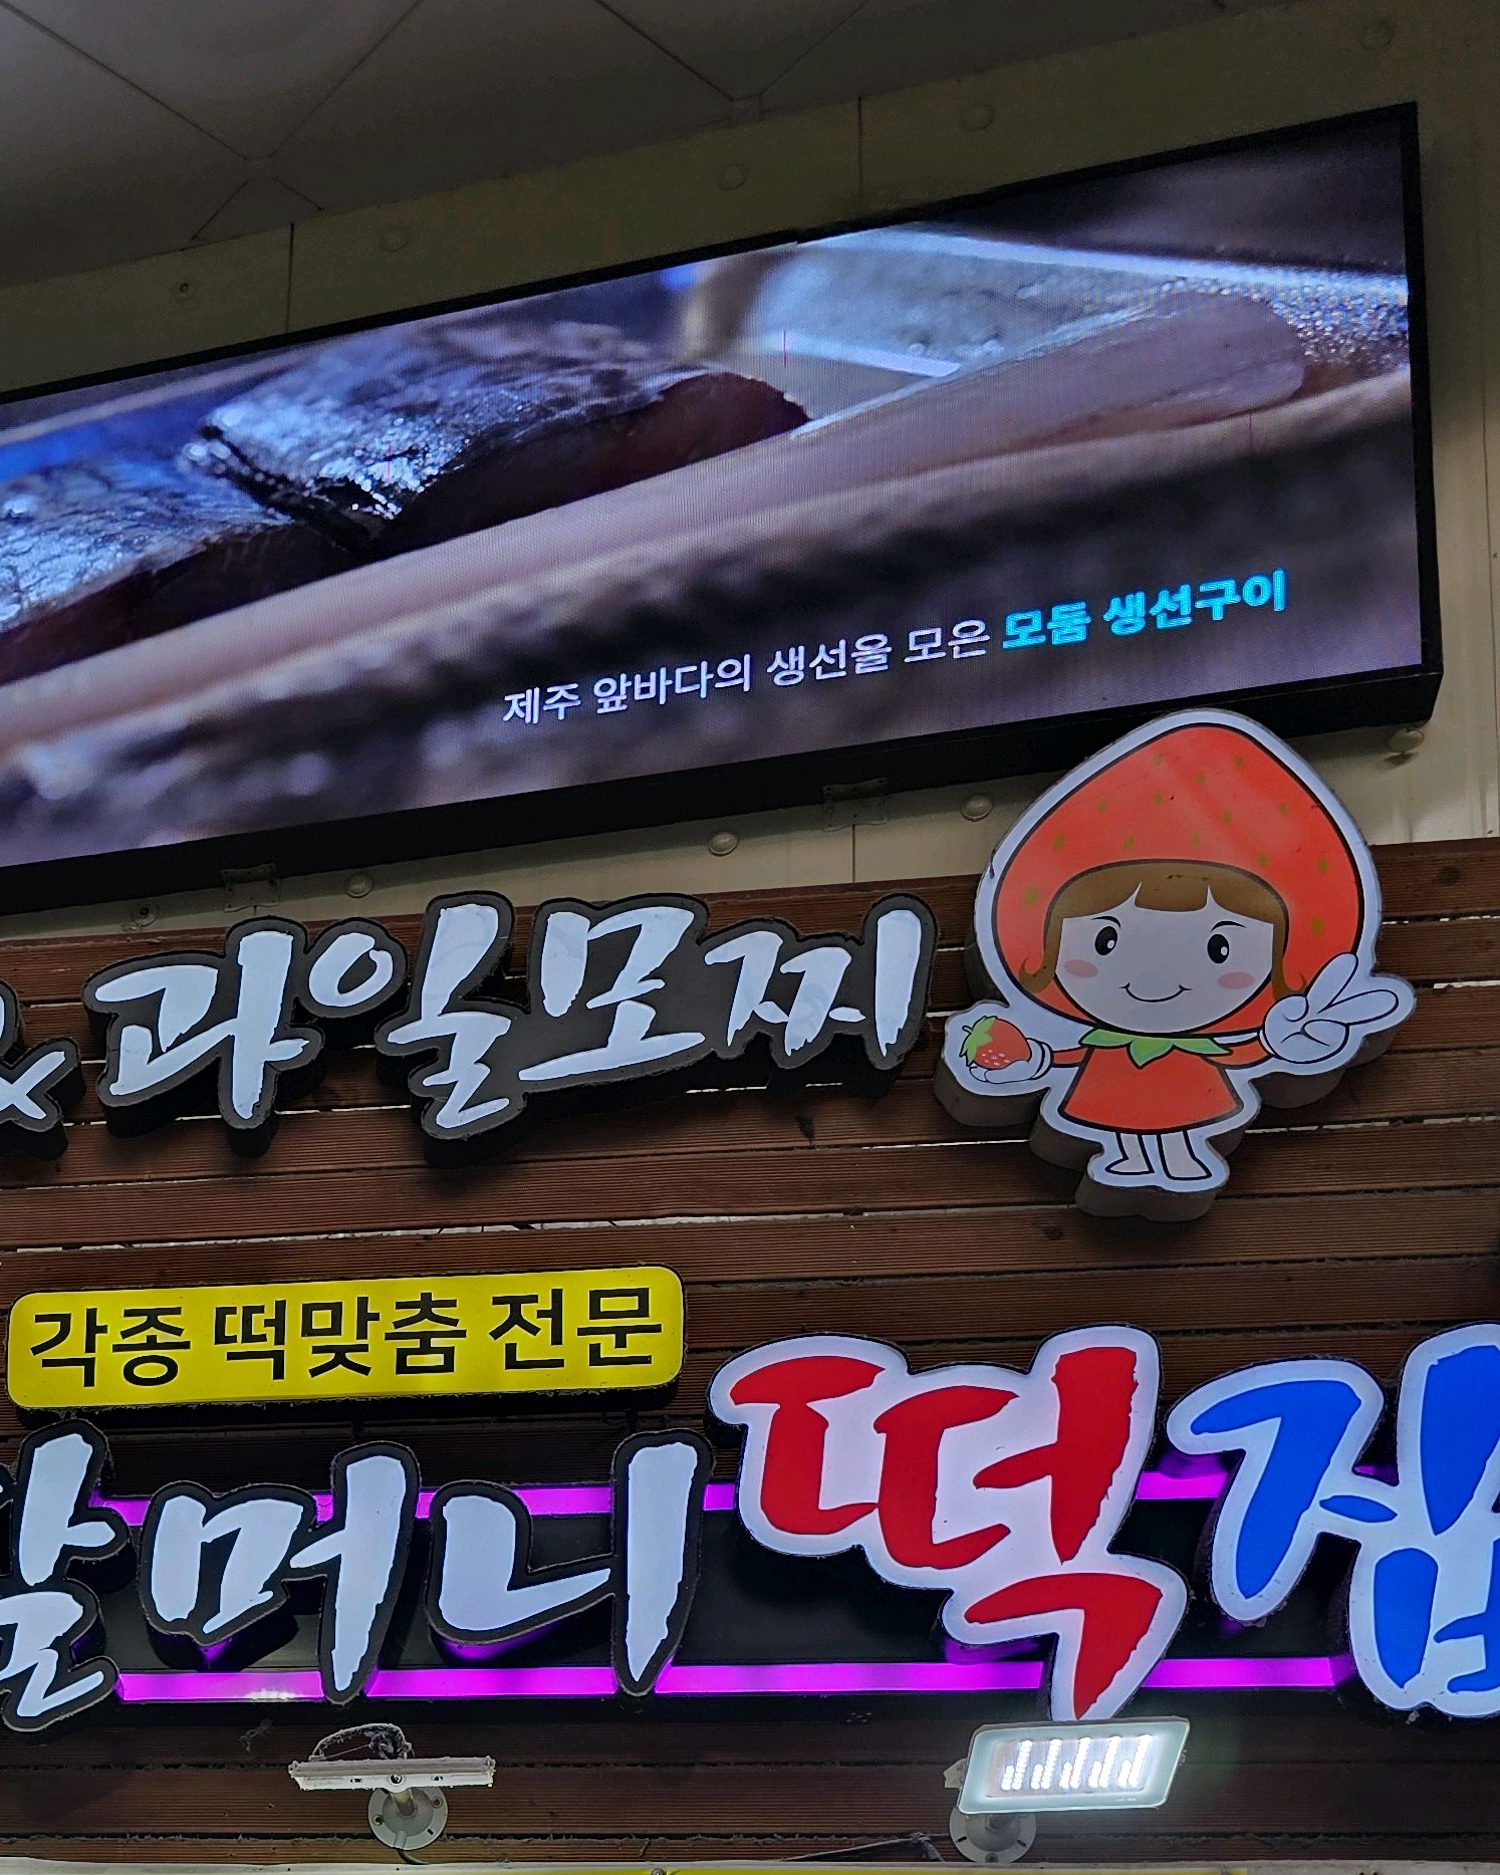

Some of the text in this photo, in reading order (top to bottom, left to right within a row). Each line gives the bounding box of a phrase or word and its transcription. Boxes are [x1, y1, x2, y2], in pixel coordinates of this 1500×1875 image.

[503, 568, 1287, 726] 제주 앞바다의 생선을 모은 모둠 생선구이
[97, 903, 922, 1129] 과일모찌
[30, 1285, 664, 1389] 각종 떡맞춤 전문
